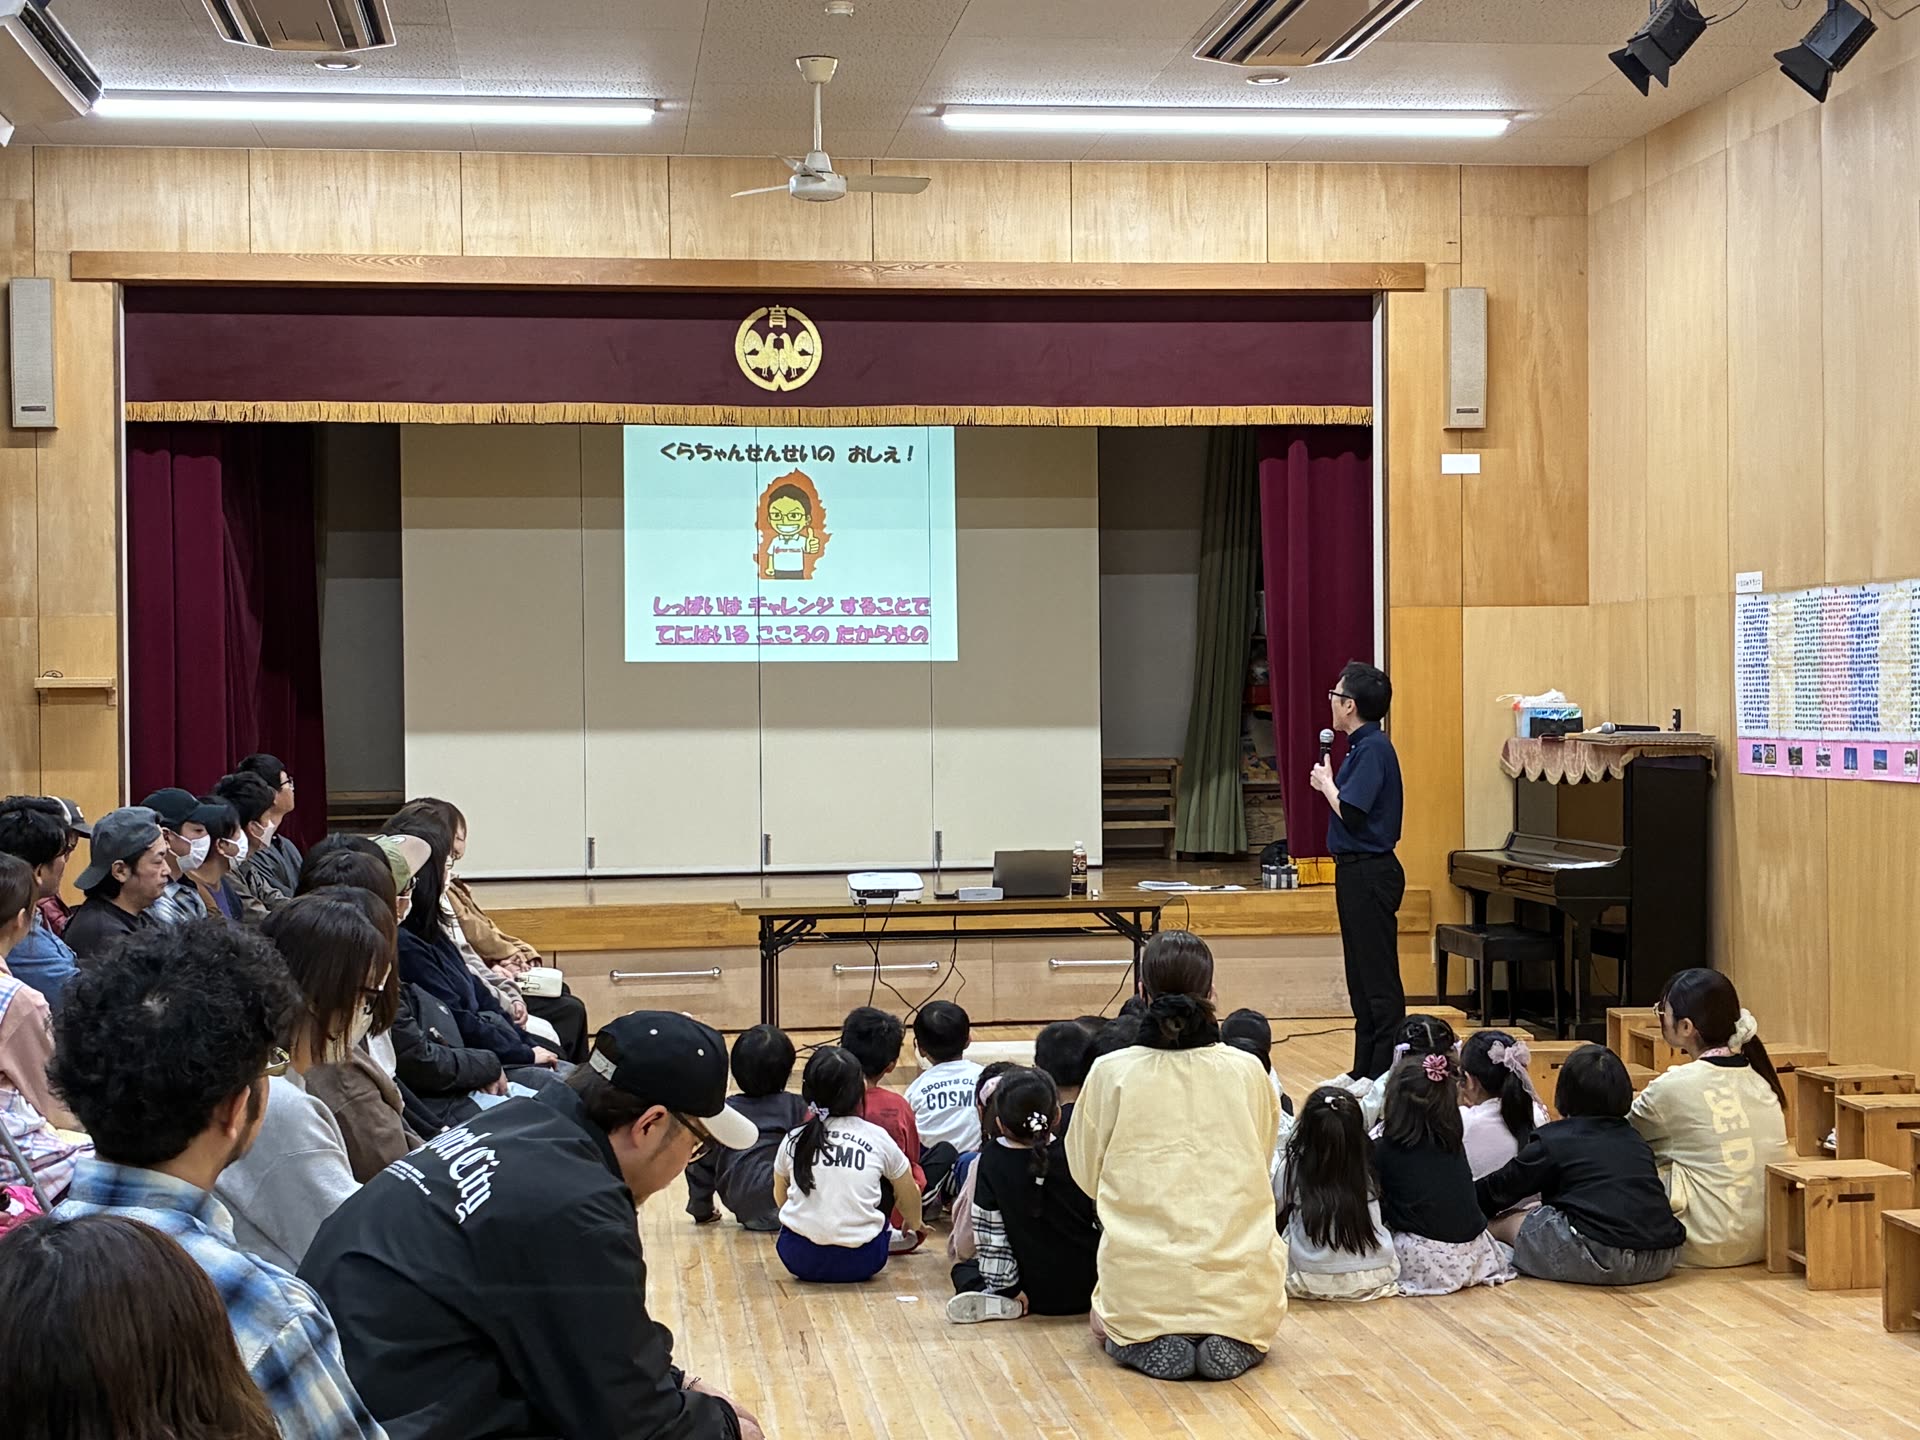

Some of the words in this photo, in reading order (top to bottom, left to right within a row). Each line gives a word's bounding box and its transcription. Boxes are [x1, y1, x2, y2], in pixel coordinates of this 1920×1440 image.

[660, 442, 835, 463] くらちゃんせんせいの
[848, 445, 914, 463] おしえ！
[748, 596, 834, 615] チャレンジ
[840, 597, 931, 615] することで
[656, 625, 749, 644] てにはいる
[757, 625, 829, 644] こころの
[836, 625, 929, 644] たからもの
[921, 1078, 960, 1095] SPORTS
[962, 1078, 975, 1086] CL
[926, 1090, 976, 1110] COSM
[842, 1132, 873, 1152] CLUB
[812, 1145, 866, 1171] OSMO
[449, 1146, 501, 1224] City
